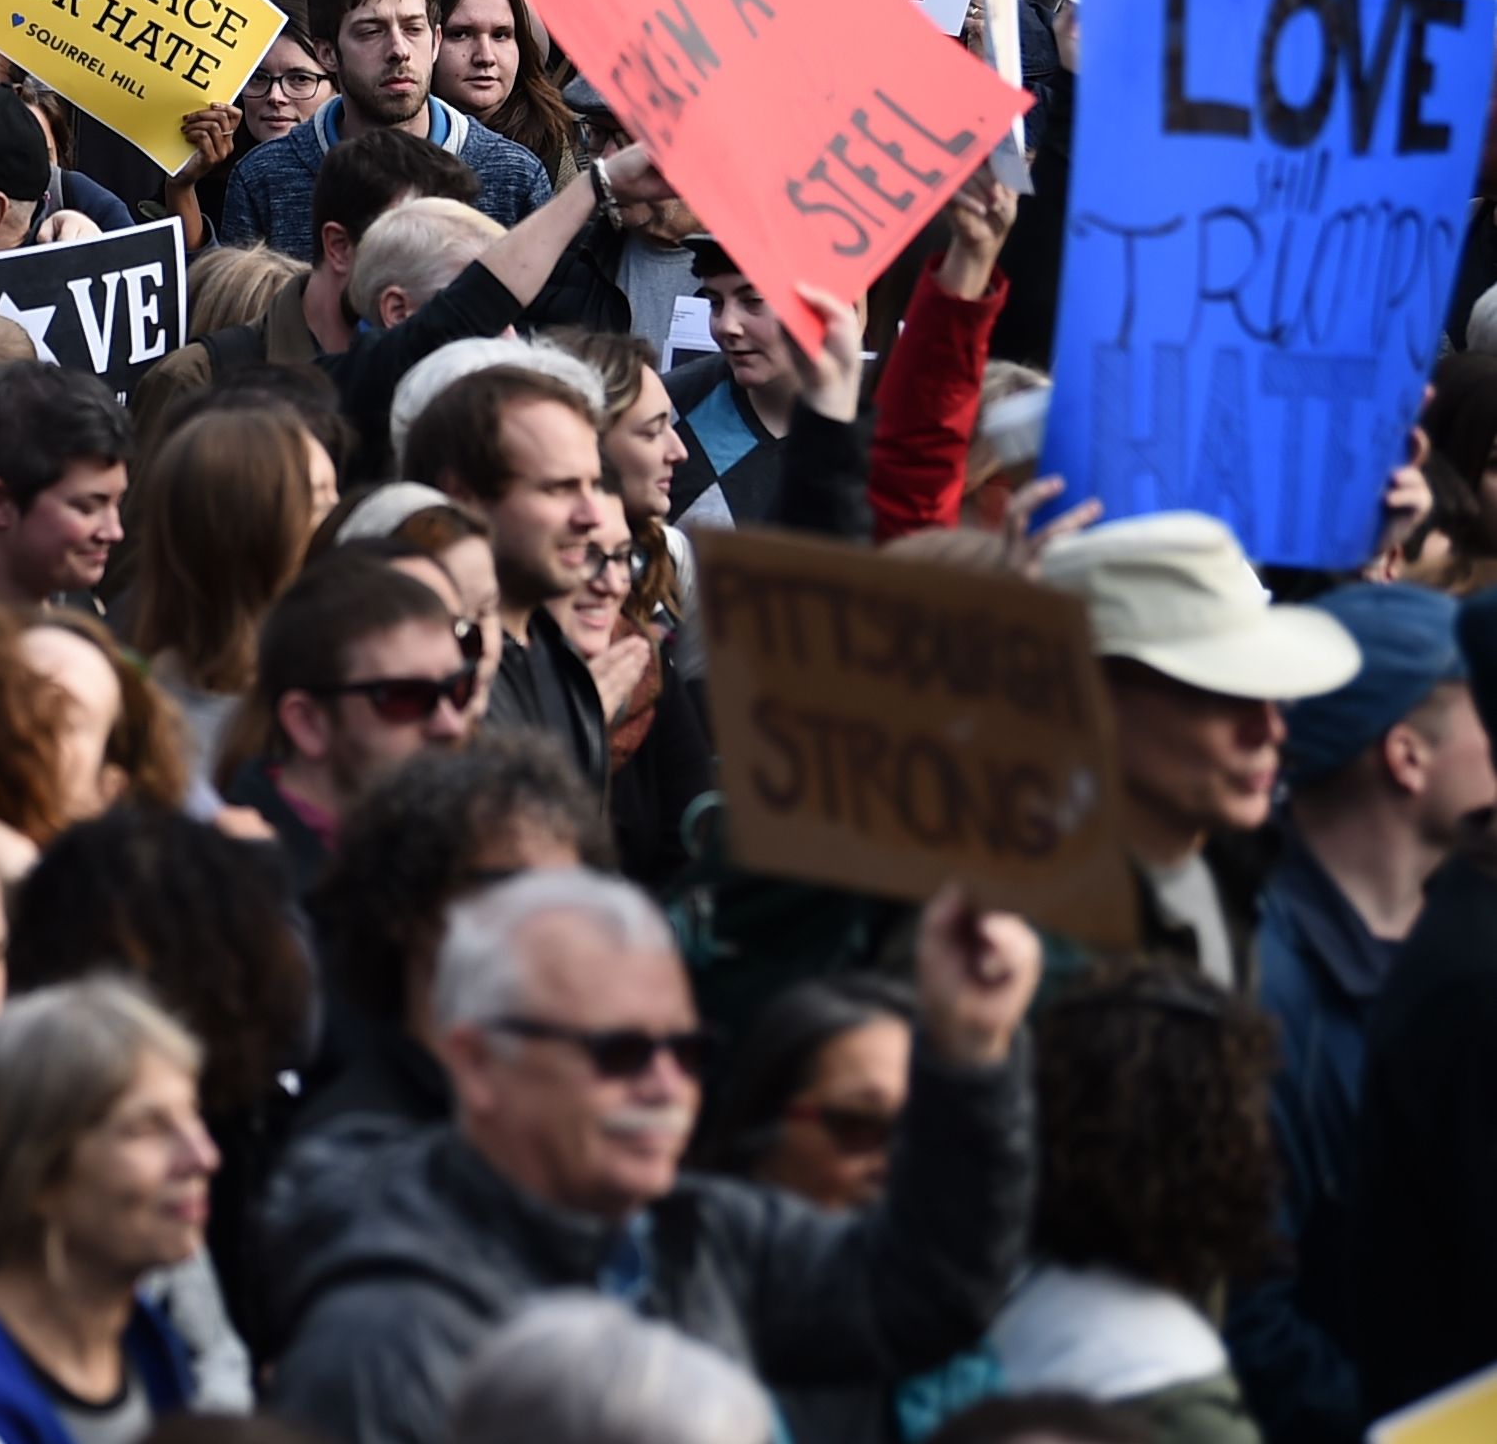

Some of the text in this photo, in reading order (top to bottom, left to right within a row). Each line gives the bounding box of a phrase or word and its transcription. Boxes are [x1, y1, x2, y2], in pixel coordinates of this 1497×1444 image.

[25, 21, 147, 101] SQUIRREL HILL
[1069, 199, 1458, 371] TRUMPS
[1089, 341, 1401, 561] HATE
[749, 696, 1059, 858] STRONG
